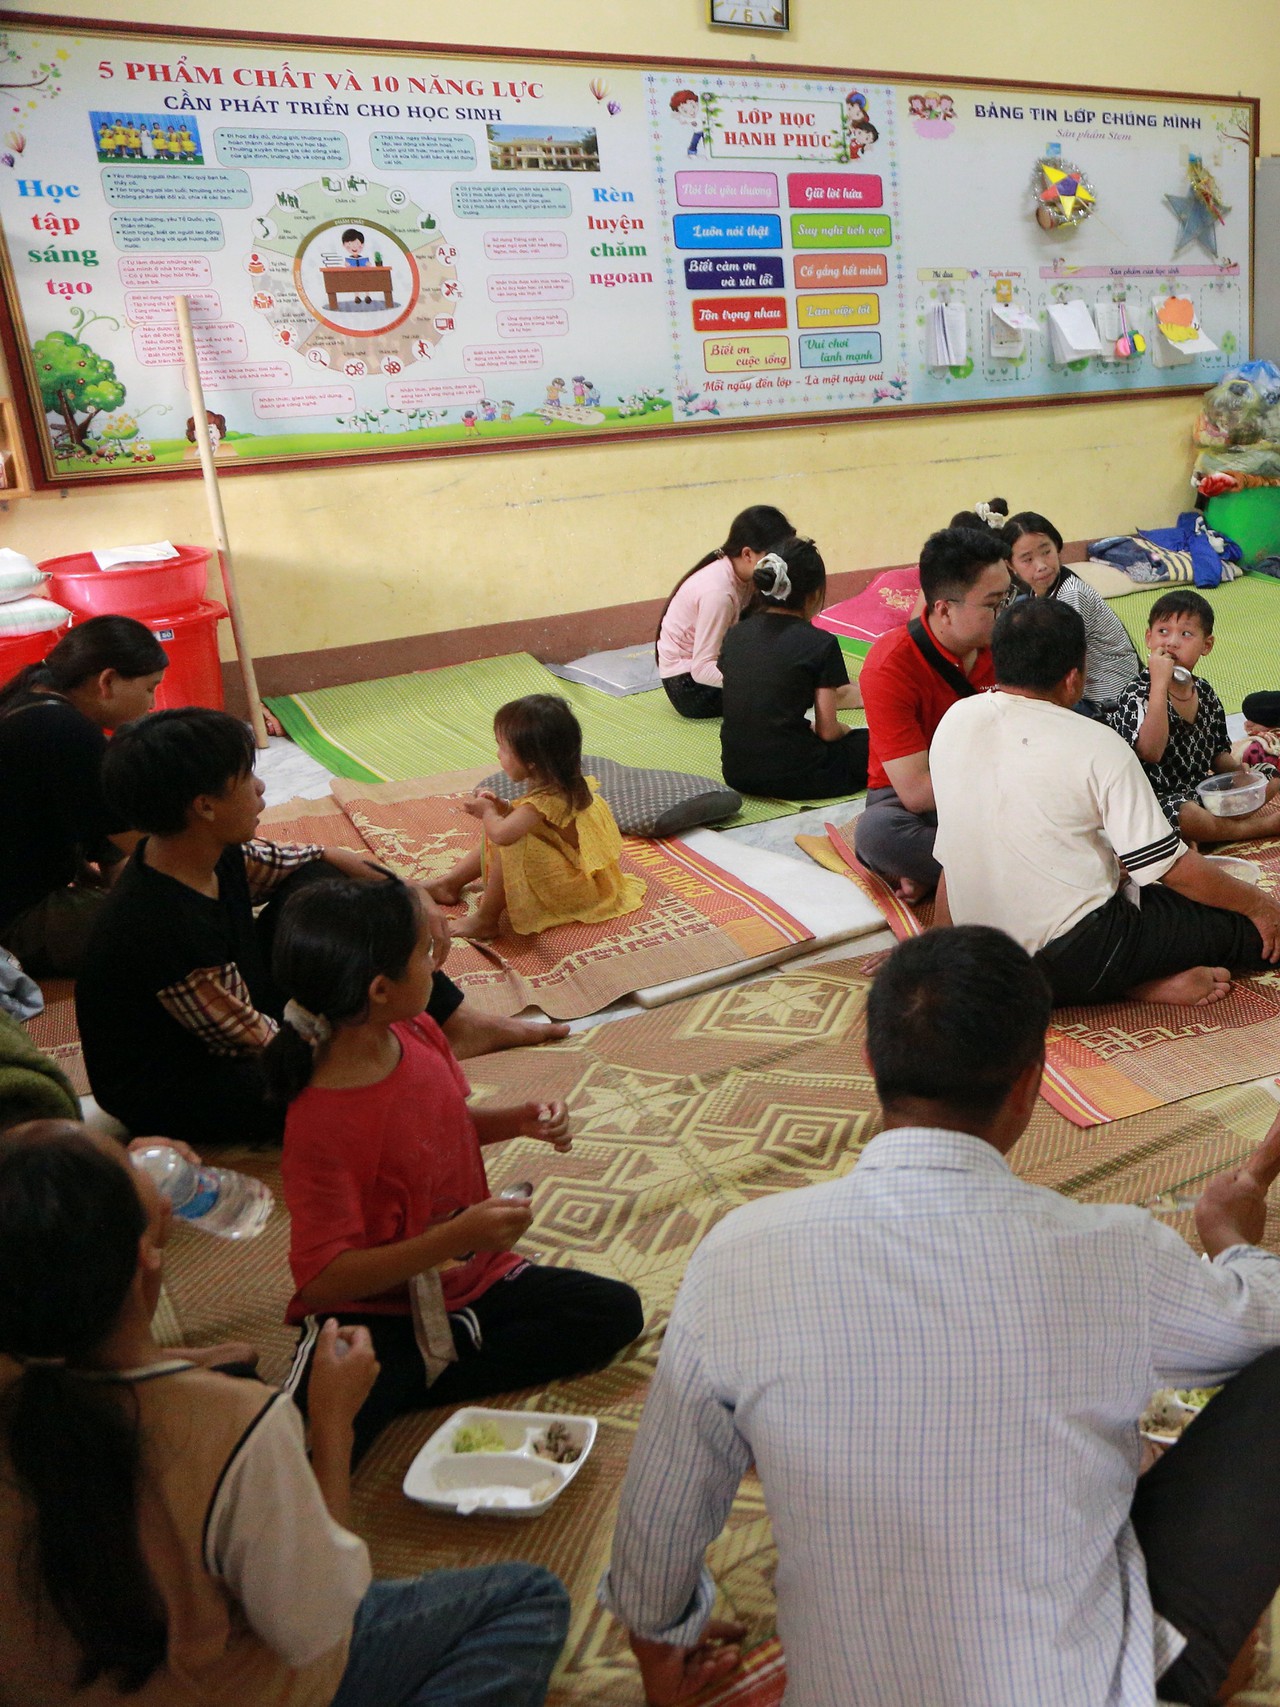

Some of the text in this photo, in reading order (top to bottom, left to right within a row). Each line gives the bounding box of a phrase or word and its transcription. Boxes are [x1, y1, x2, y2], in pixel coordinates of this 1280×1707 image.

[744, 8, 752, 22] 6
[98, 55, 544, 103] 5 PHẨM CHẤT VÀ 10 NĂNG LỰC
[164, 88, 502, 122] CẦN PHÁT TRIỂN CHO HỌC SINH
[737, 108, 815, 128] LỚP HỌC
[975, 101, 1201, 129] BẢNG TIN LỚP CHÚNG MÌNH
[724, 131, 831, 148] HẠNH PHÚC
[1108, 131, 1131, 141] Stem
[16, 179, 81, 203] Học
[592, 187, 634, 202] Rèn
[805, 187, 862, 201] Giữ lời hứa
[31, 212, 80, 236] tập
[587, 214, 644, 234] luyện
[797, 224, 818, 236] Suy
[821, 224, 844, 237] nghĩ
[726, 225, 744, 237] nói
[747, 225, 769, 239] thật
[28, 245, 99, 267] sáng
[590, 242, 647, 257] chăm
[688, 259, 757, 273] Biết cảm ơn
[800, 264, 883, 279] Cố gắng hết mình
[589, 272, 653, 287] ngoan
[721, 273, 773, 287] và xin lỗi
[45, 279, 93, 300] tạo
[699, 307, 781, 323] Tôn trọng nhau
[806, 303, 870, 317] Làm việc tốt
[710, 342, 750, 356] Biết ơn
[804, 337, 850, 350] Vui chơi
[736, 352, 786, 369] cuộc sống
[846, 350, 873, 363] mạnh
[703, 379, 724, 392] Mỗi
[727, 380, 752, 393] ngày
[755, 376, 774, 389] đến
[776, 376, 792, 388] lớp
[805, 374, 819, 385] Là
[823, 374, 841, 385] một
[843, 373, 866, 385] ngày
[869, 371, 884, 382] vui
